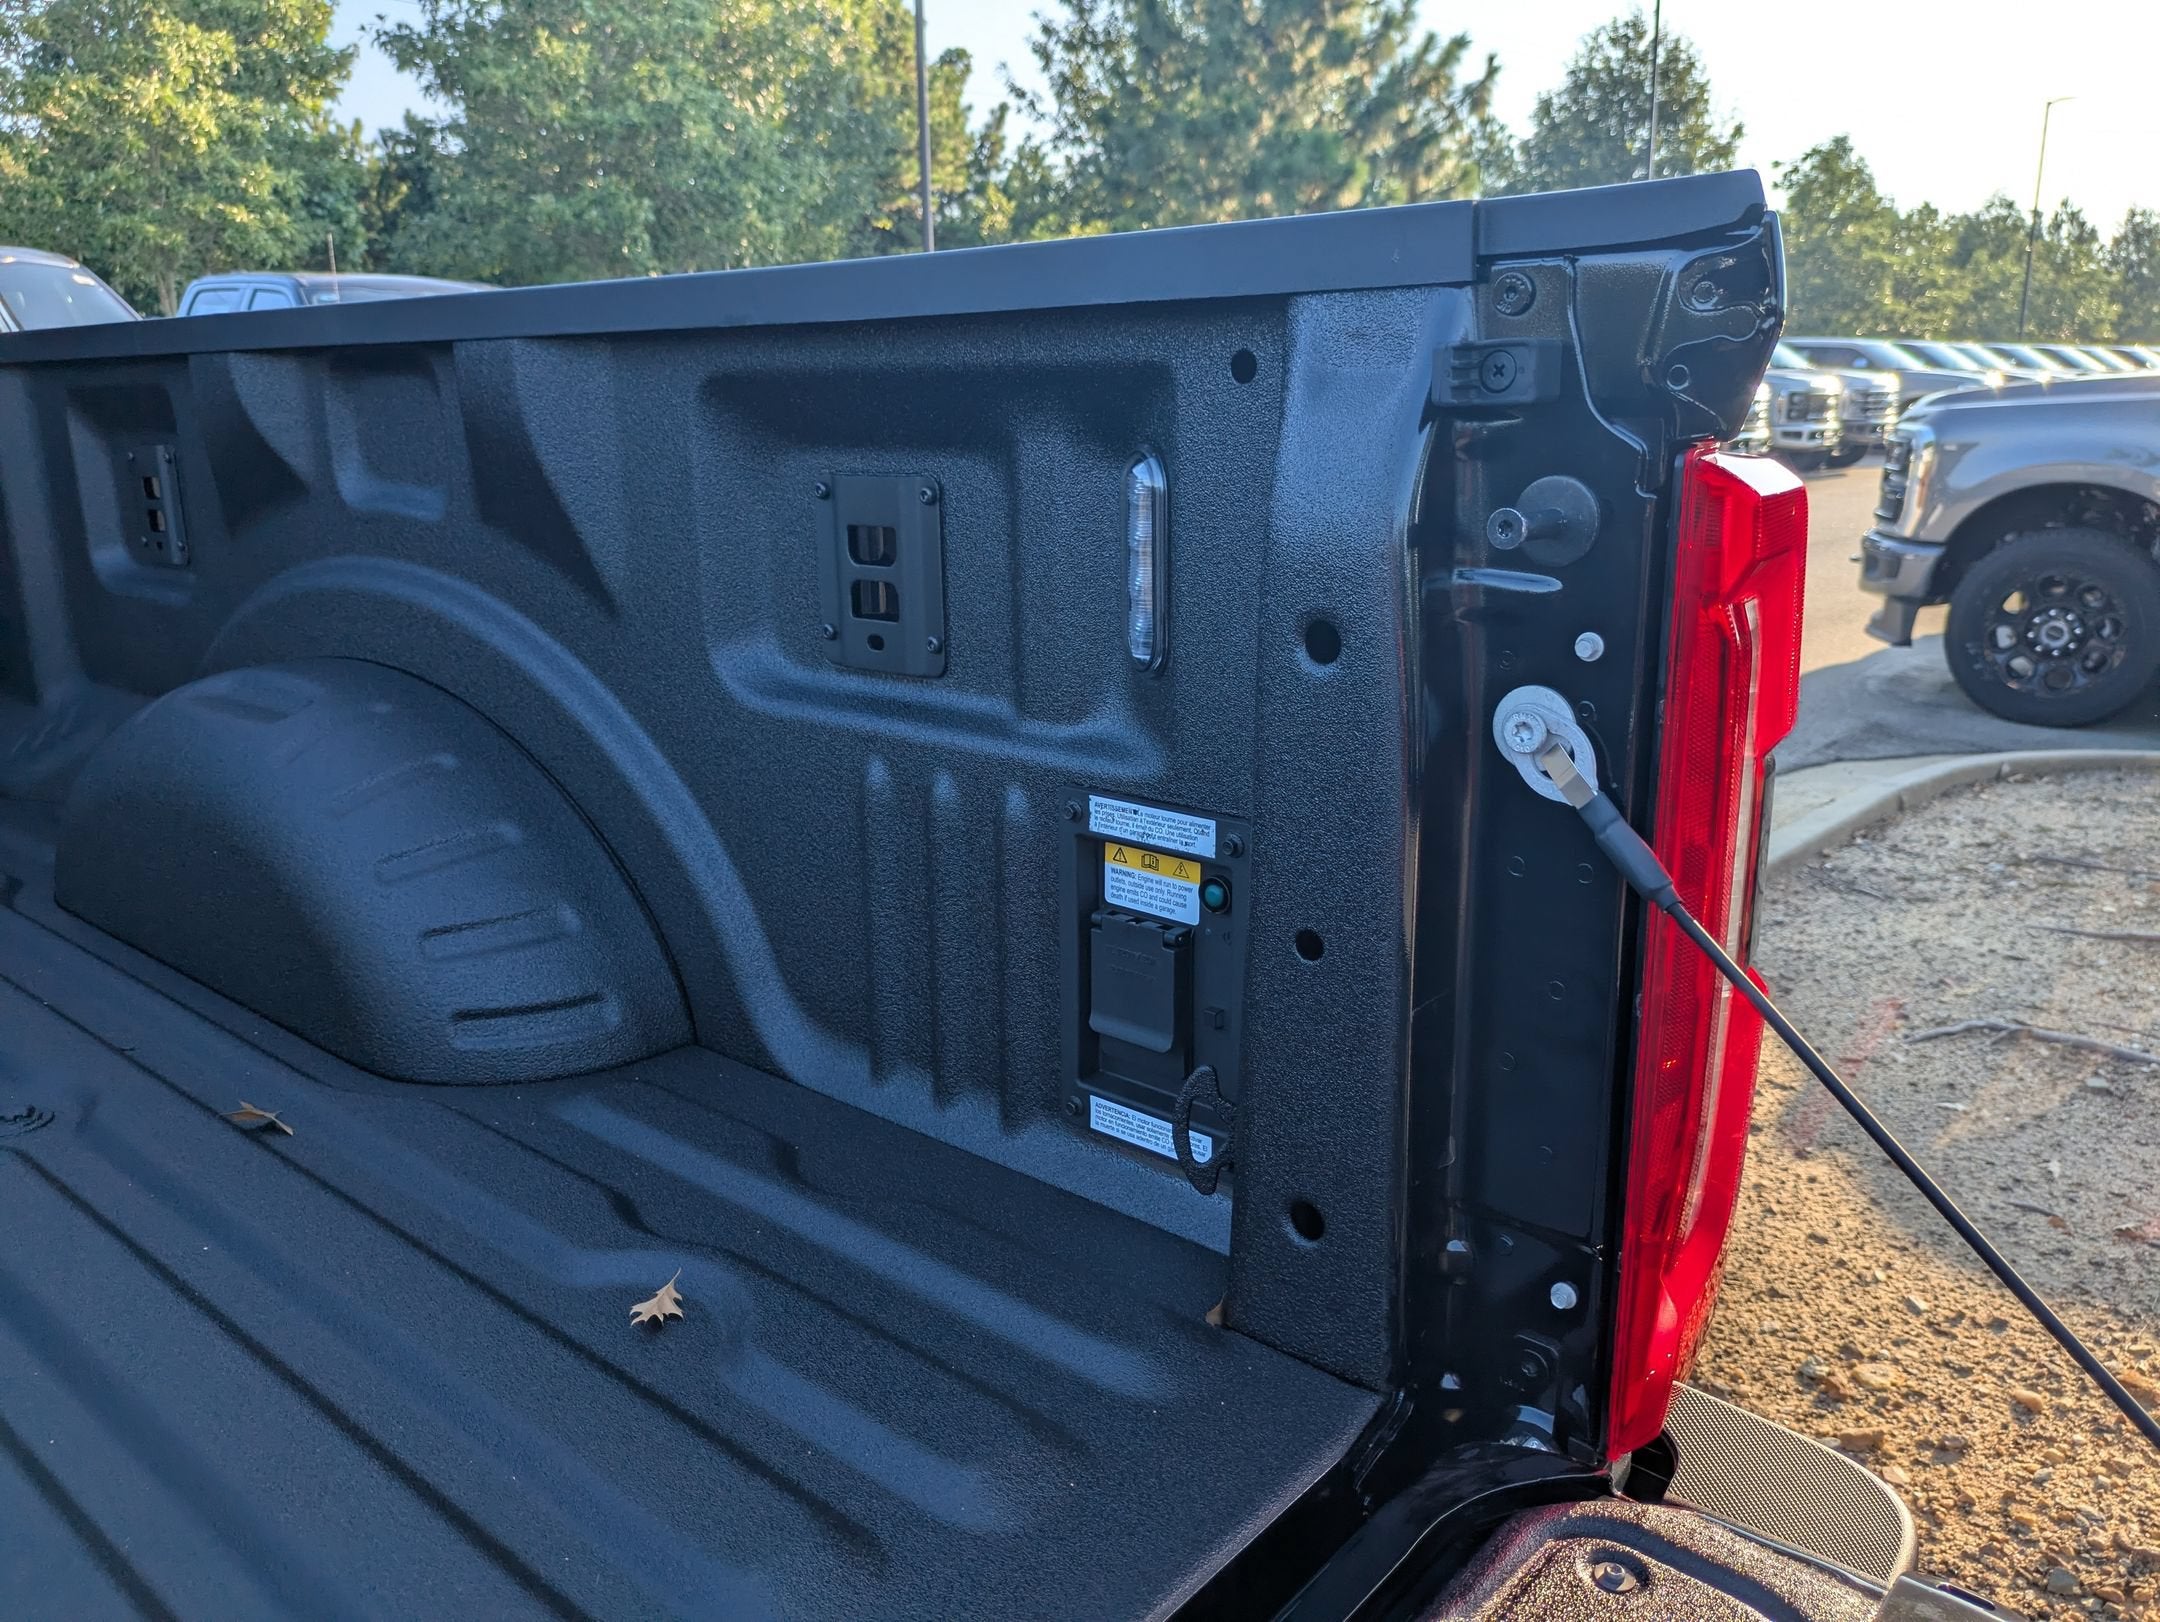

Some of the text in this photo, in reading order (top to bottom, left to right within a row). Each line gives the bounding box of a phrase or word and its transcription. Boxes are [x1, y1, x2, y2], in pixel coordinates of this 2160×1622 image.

[1110, 866, 1136, 879] WARNING:
[1137, 873, 1153, 885] Engine
[1154, 877, 1162, 885] will
[1178, 884, 1193, 895] power
[1110, 875, 1126, 886] outlets,
[1127, 879, 1144, 889] outside
[1166, 888, 1187, 902] Running
[1110, 884, 1186, 909] engine emits CO and could cause
[1110, 891, 1123, 900] death
[1127, 895, 1139, 904] used
[1140, 898, 1153, 908] inside
[1158, 905, 1176, 916] garage.
[1095, 1101, 1130, 1118] ADVERTENCIA:
[1136, 1117, 1149, 1126] motor
[1095, 1114, 1107, 1123] motor
[1115, 1120, 1147, 1136] funcionamiento
[1148, 1132, 1160, 1141] emite
[1161, 1136, 1169, 1145] CO
[1100, 1122, 1115, 1131] muerte
[1135, 1122, 1145, 1130] usar
[1146, 1125, 1169, 1138] solamente
